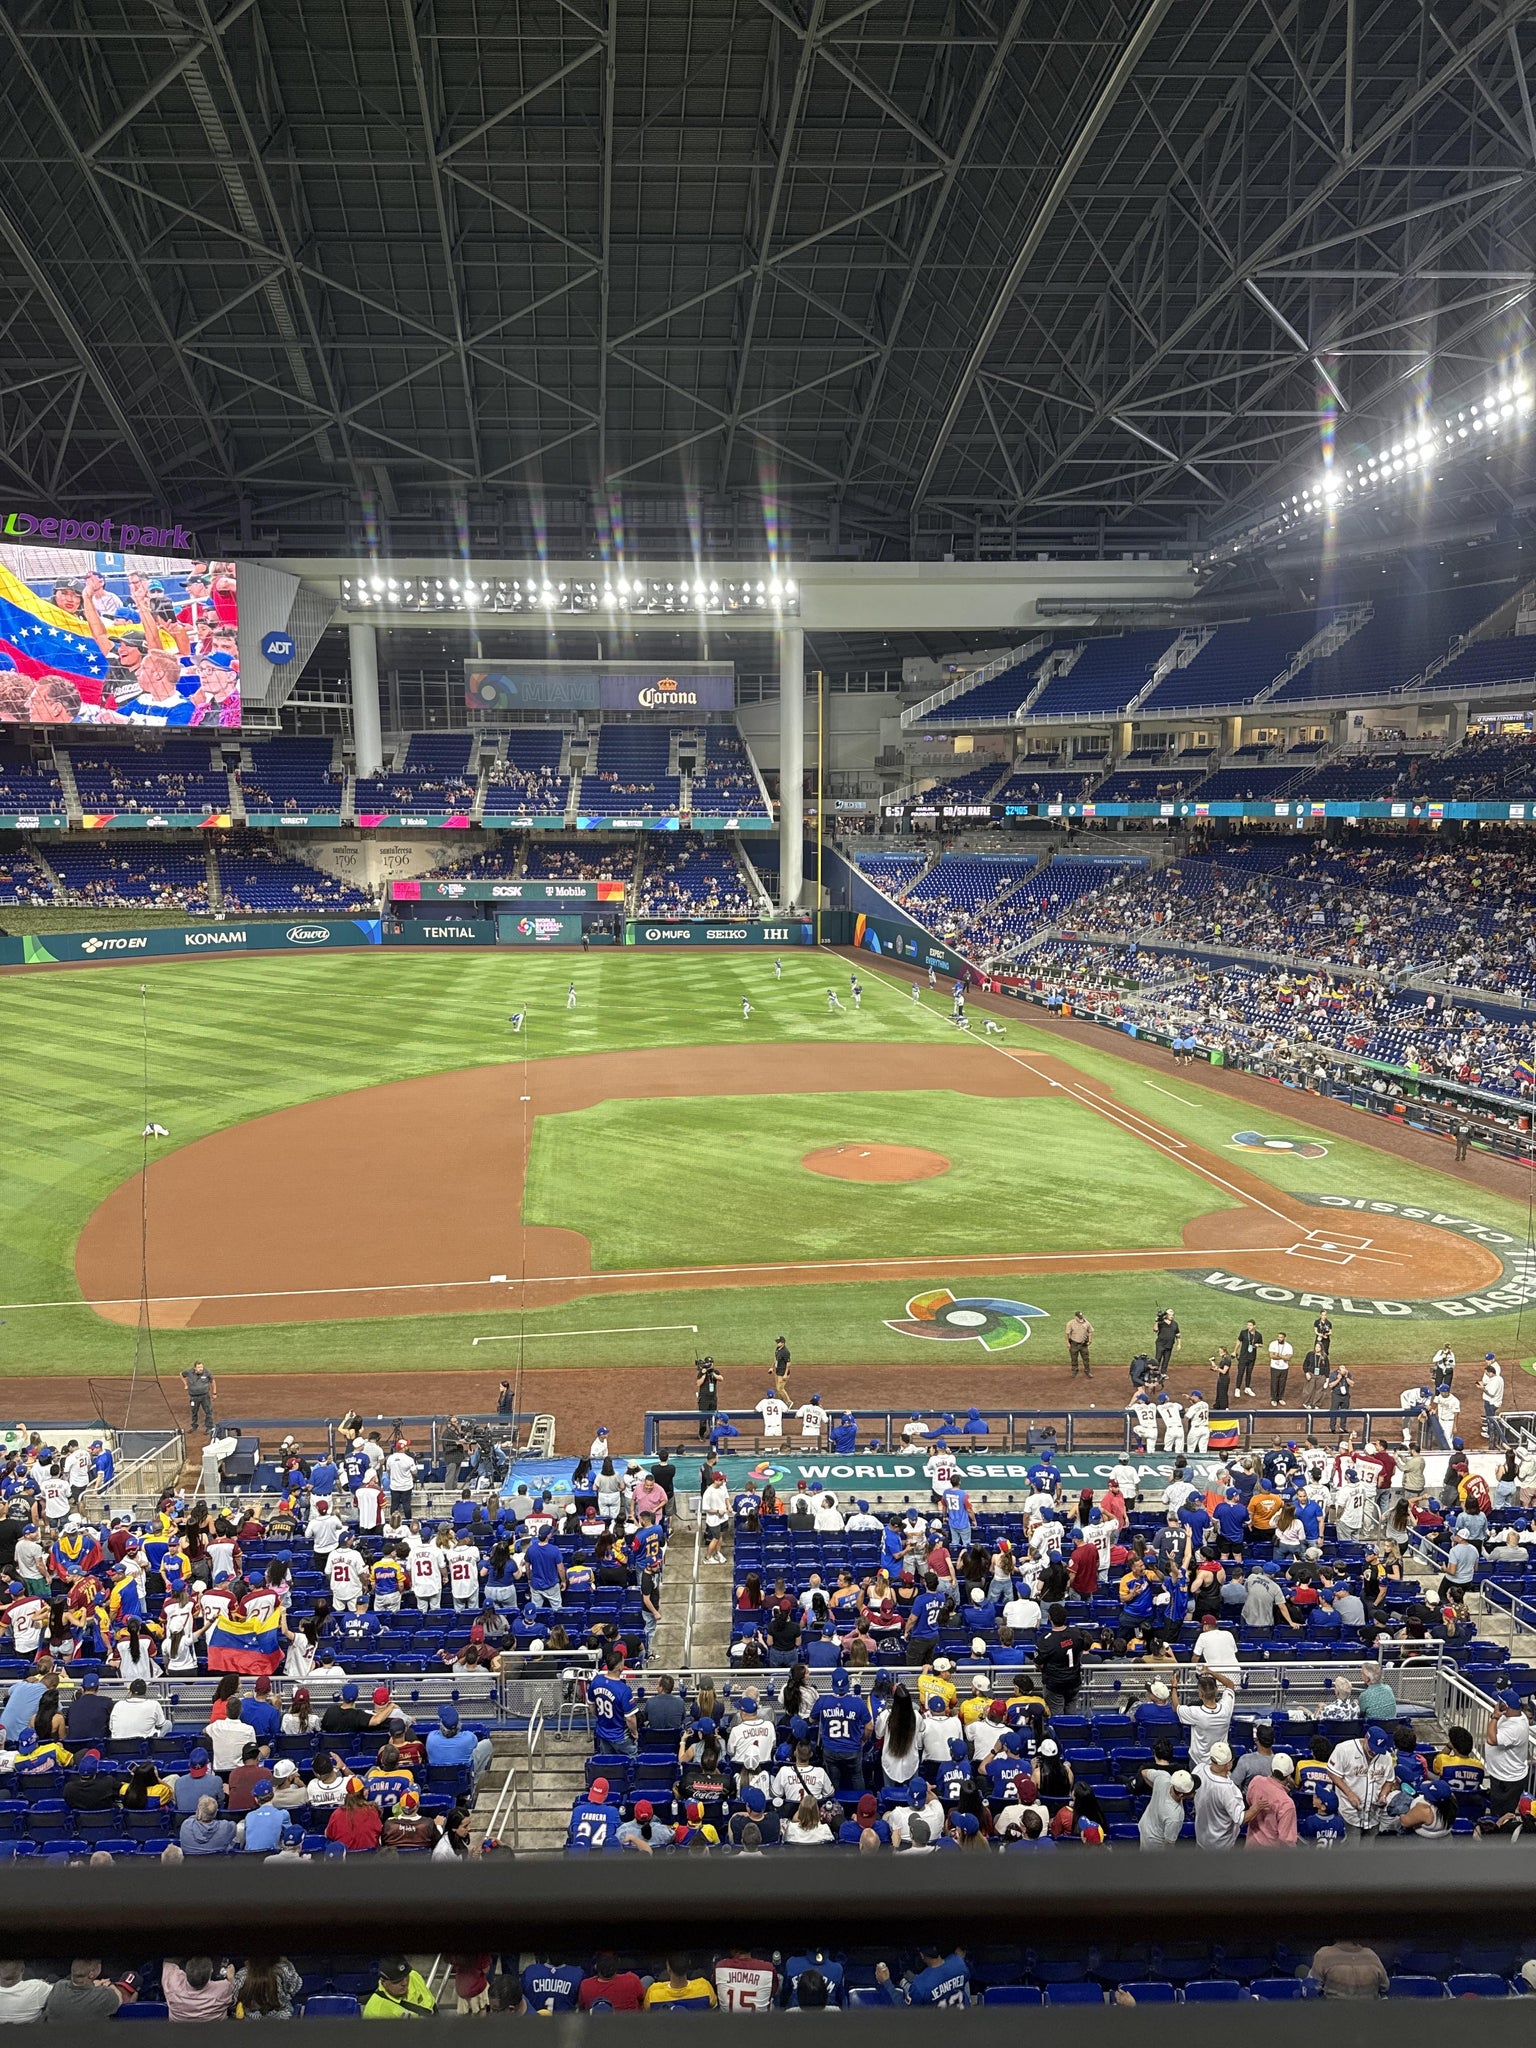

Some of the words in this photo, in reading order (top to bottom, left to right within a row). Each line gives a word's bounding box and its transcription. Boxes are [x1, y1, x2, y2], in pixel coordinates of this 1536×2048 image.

[0, 513, 114, 545] Depot
[119, 524, 192, 550] park
[267, 642, 292, 654] ADT
[522, 682, 595, 702] MIAMI
[638, 687, 697, 708] Corona
[885, 806, 904, 817] 6:57
[968, 806, 991, 816] RAFFLE
[407, 818, 428, 826] Mobile
[335, 855, 357, 869] 1796
[384, 855, 410, 869] 1796
[492, 886, 522, 896] SCSK
[556, 886, 586, 897] Mobile
[185, 931, 247, 946] KONAMI
[291, 927, 329, 940] Kowa
[423, 927, 475, 938] TENTIAL
[662, 930, 691, 939] MUFG
[706, 929, 747, 939] SEIKO
[763, 928, 789, 940] IHI
[103, 939, 127, 950] ITO
[128, 937, 148, 949] EN
[930, 948, 945, 959] EXPECT
[925, 956, 950, 971] EVERYTHING
[1318, 1195, 1515, 1244] CLASSIC
[1203, 1271, 1414, 1316] WORLD
[806, 1413, 819, 1425] 83
[1141, 1410, 1155, 1421] 23
[1166, 1408, 1173, 1418] 1
[80, 1457, 88, 1467] 21
[348, 1464, 360, 1475] 21
[798, 1465, 916, 1478] WORLD
[922, 1465, 1090, 1478] ASEBL
[937, 1468, 952, 1481] 21
[1360, 1470, 1375, 1483] 13
[47, 1489, 60, 1499] 21
[1471, 1481, 1486, 1499] 24
[1354, 1496, 1362, 1509] 21
[1165, 1531, 1186, 1539] DAD
[646, 1542, 659, 1557] 13
[1047, 1538, 1060, 1550] 21
[1094, 1538, 1107, 1550] 21
[1172, 1539, 1180, 1552] 1
[334, 1566, 351, 1582] 21
[415, 1560, 433, 1577] 13
[452, 1563, 471, 1581] 21
[927, 1609, 940, 1626] 21
[1066, 1648, 1075, 1668] 1
[595, 1696, 614, 1719] 99
[823, 1708, 845, 1719] ACUÑA
[846, 1710, 857, 1721] JR
[742, 1727, 769, 1740] CHOURIO
[828, 1719, 851, 1739] 21
[1455, 1770, 1479, 1781] ALTUVE
[312, 1791, 335, 1803] ACUÑA
[581, 1812, 607, 1821] CABRERA
[576, 1821, 607, 1846] 24
[1316, 1827, 1338, 1839] ACUÑA
[726, 1971, 761, 1986] JHOMAR
[532, 1979, 572, 1995] CHOURIO
[931, 1974, 965, 2001] JEANFRED
[726, 1989, 757, 2013] 15
